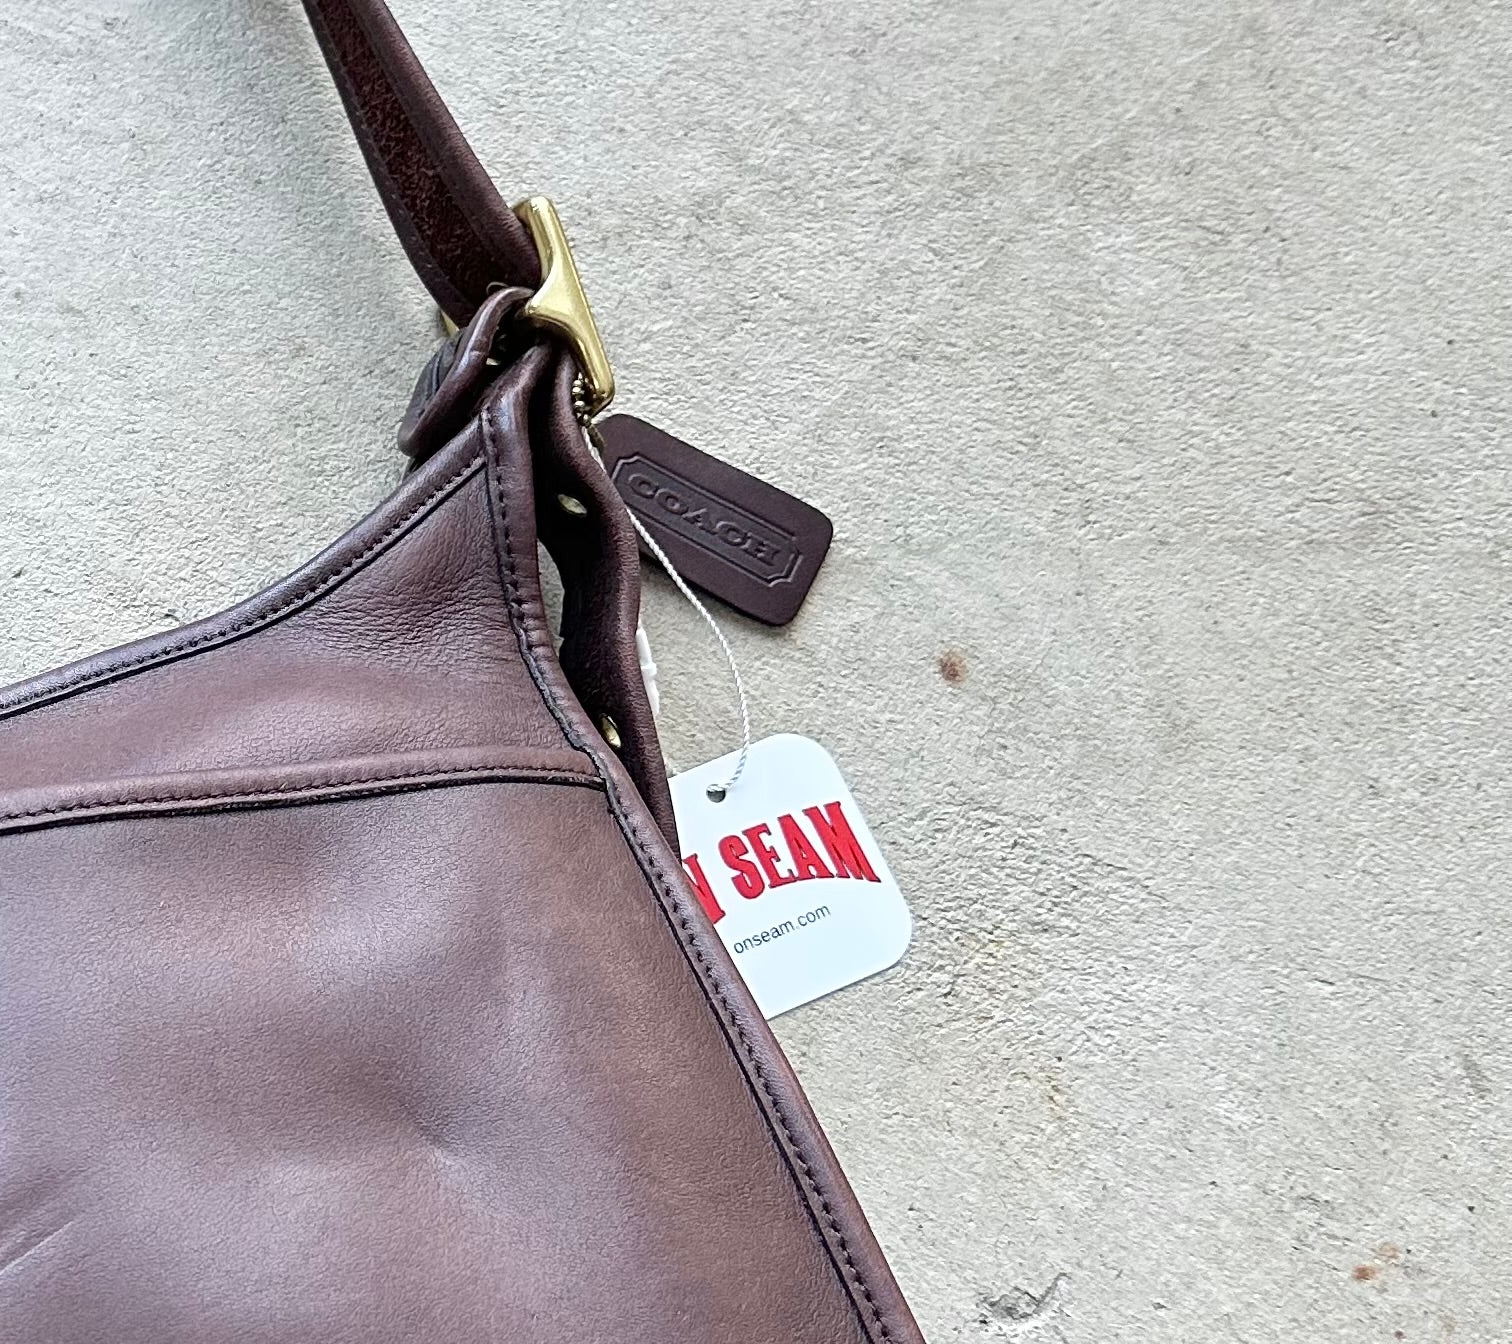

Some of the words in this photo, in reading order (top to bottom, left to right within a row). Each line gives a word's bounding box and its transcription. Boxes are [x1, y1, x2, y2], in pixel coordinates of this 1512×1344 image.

[628, 472, 782, 567] COACH
[718, 801, 881, 899] SEAM
[733, 905, 831, 954] onseam.com
